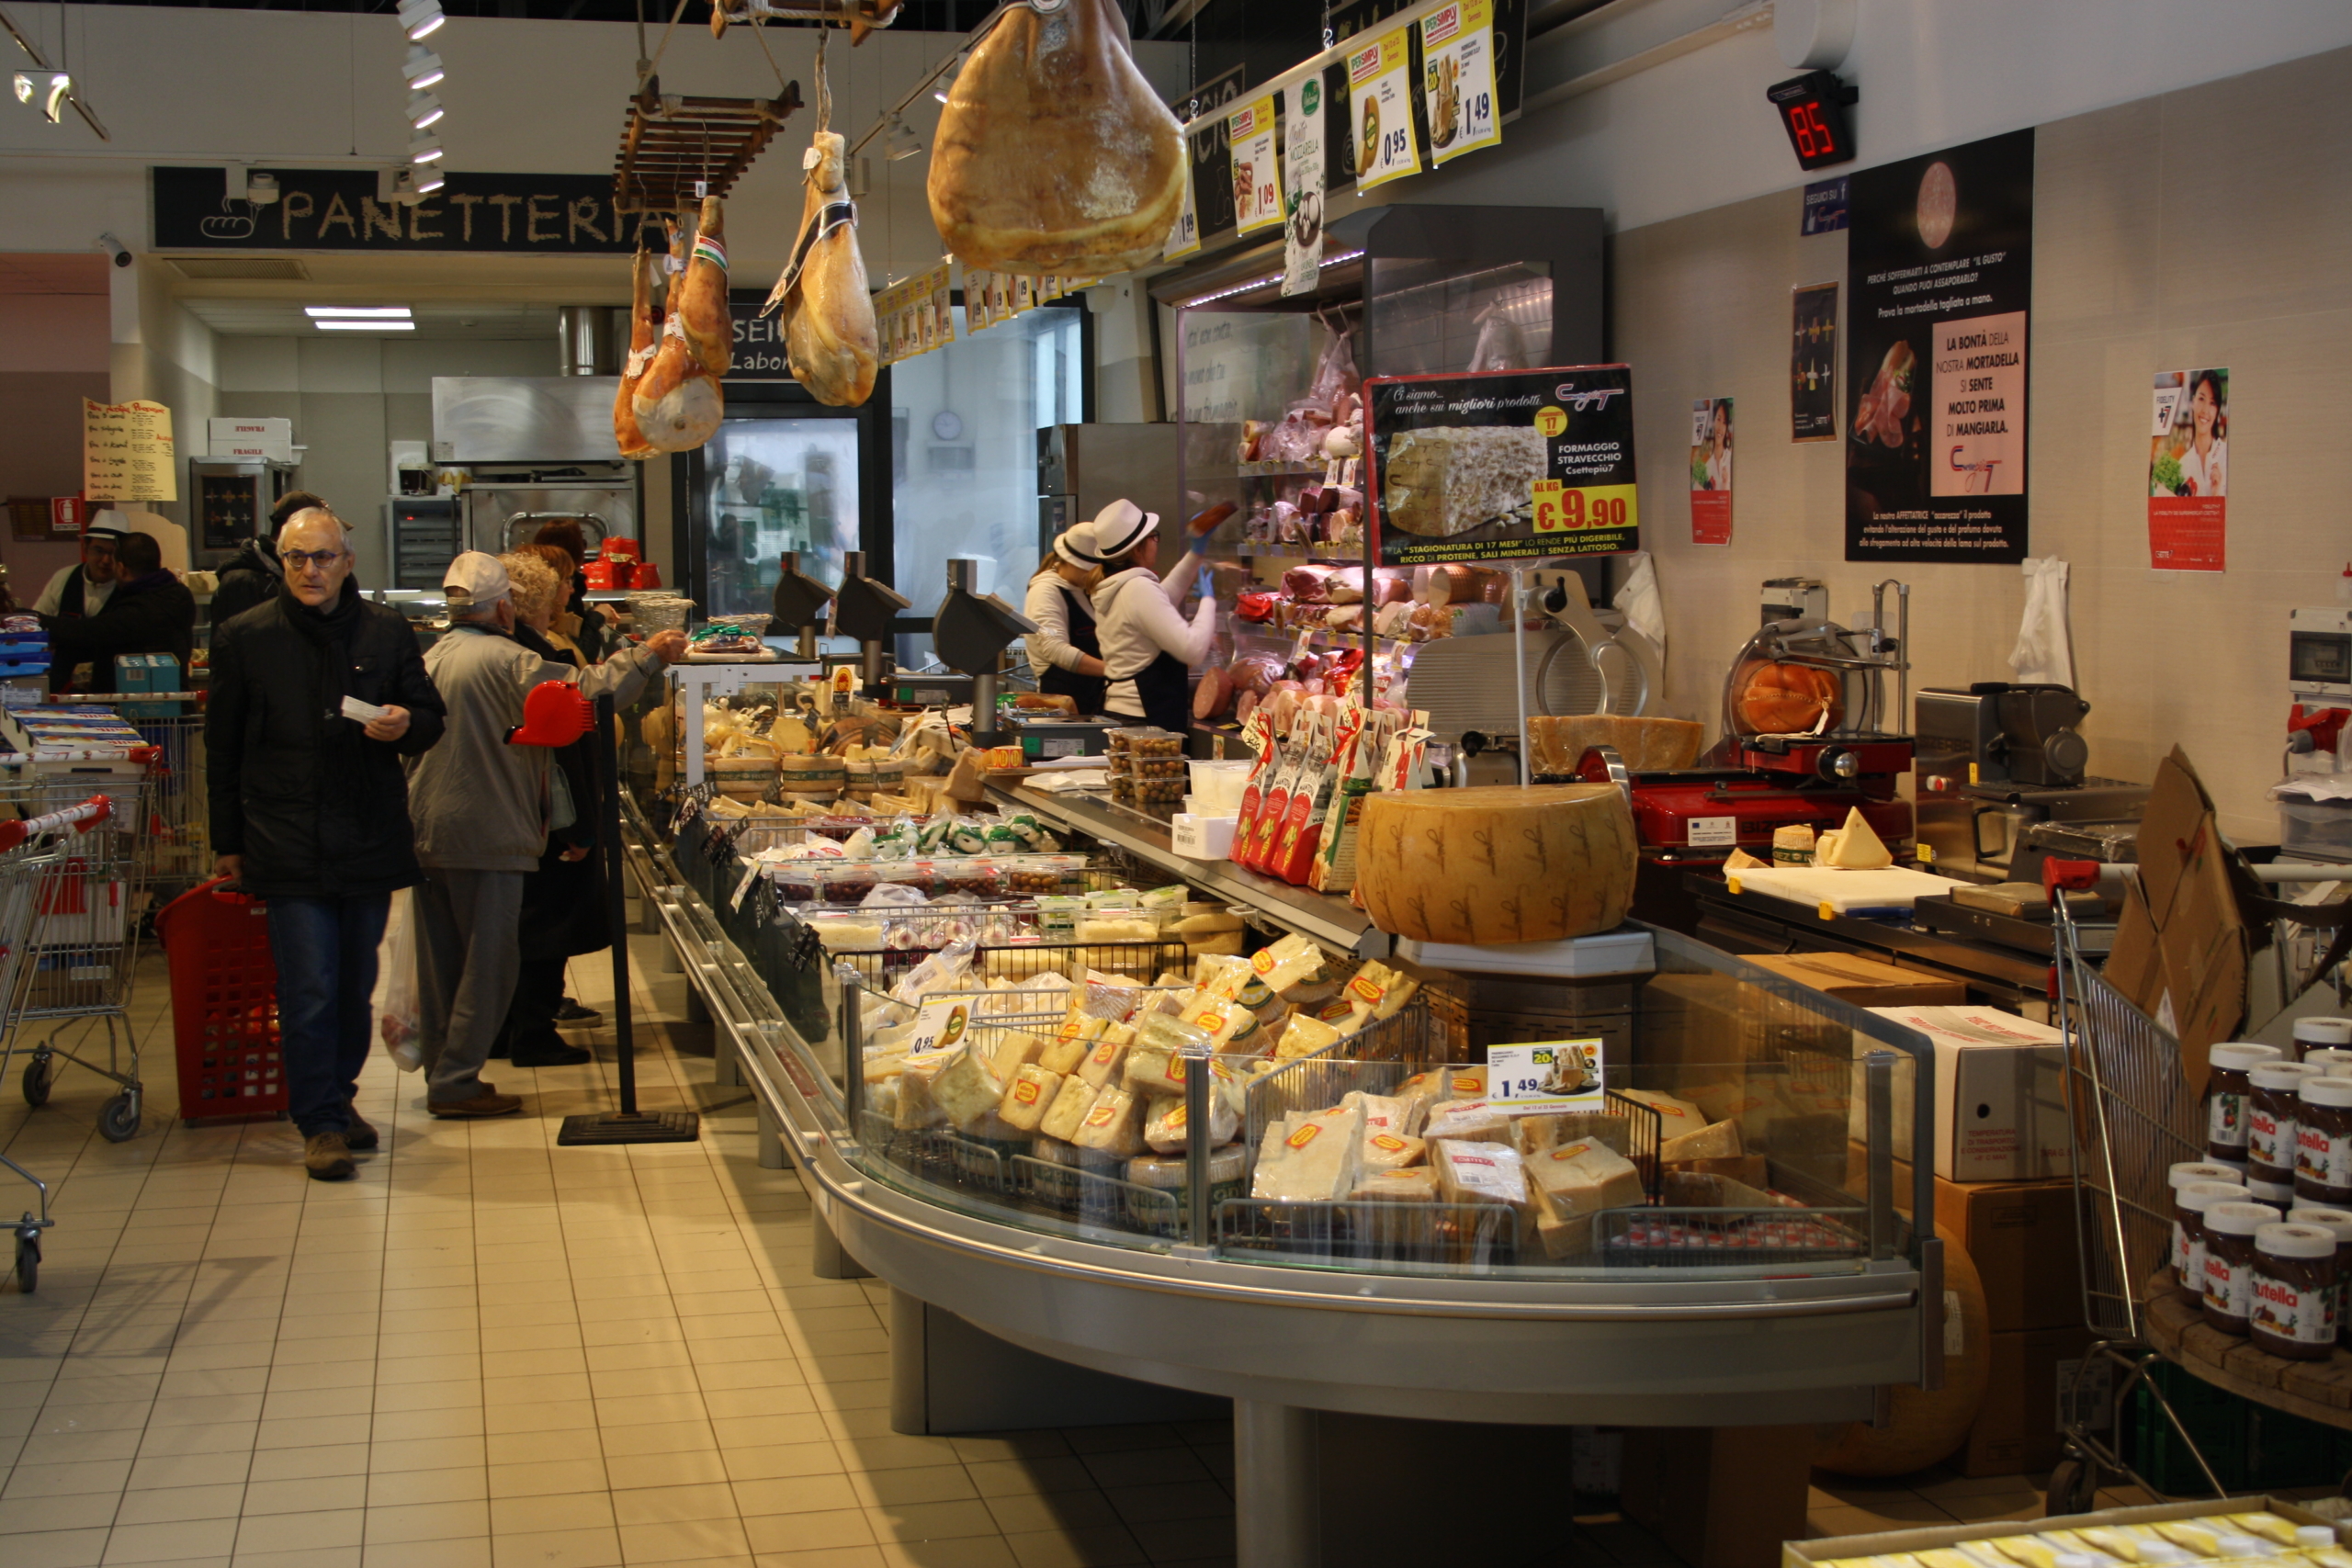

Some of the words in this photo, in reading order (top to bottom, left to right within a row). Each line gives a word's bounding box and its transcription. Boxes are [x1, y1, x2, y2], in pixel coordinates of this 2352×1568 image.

[1790, 102, 1835, 158] 85
[1290, 139, 1319, 161] MOZZARELLA
[1806, 191, 1828, 205] SEGUICI
[1829, 189, 1838, 200] SU
[282, 191, 669, 243] PANETTERIA
[1887, 266, 1923, 281] SOFFERMARTI
[1924, 266, 1929, 275] A
[1929, 258, 1970, 275] CONTEMPLARE
[1893, 282, 1917, 295] QUANDO
[1918, 279, 1933, 290] PUOI
[1933, 272, 1978, 288] ASSAPORARLO?
[1878, 308, 1895, 318] Prova
[1896, 304, 1903, 315] la
[1904, 299, 1938, 313] mortadella
[1939, 296, 1964, 312] tagliata
[1965, 298, 1971, 306] a
[1971, 294, 1993, 305] mano.
[1947, 337, 1956, 351] LA
[1989, 332, 2009, 345] DELLA
[1936, 359, 1963, 374] NOSTRA
[1966, 352, 2019, 370] MORTADELLA
[1961, 379, 1966, 392] SI
[1969, 377, 1993, 392] SENTE
[1394, 389, 1404, 401] Ci
[2156, 395, 2175, 404] FIDELITY
[1395, 404, 1427, 415] anche
[1430, 403, 1445, 412] sui
[1448, 397, 1495, 414] migliori
[1497, 395, 1543, 411] prodotti.
[1948, 400, 1975, 415] MOLTO
[1978, 398, 2005, 412] PRIMA
[1544, 417, 1556, 430] 17
[1947, 423, 1954, 436] DI
[1956, 420, 2008, 436] MANGIARLA.
[1558, 442, 1620, 454] FORMAGGIO
[1557, 453, 1622, 465] STRAVECCHIO
[1534, 482, 1544, 492] AL
[1546, 481, 1559, 491] KG
[1537, 502, 1555, 530] €
[1561, 490, 1626, 530] 9,90
[1895, 511, 1928, 520] AFFETTATRICE
[1963, 510, 1967, 519] il
[1968, 510, 1992, 522] prodotto
[1863, 524, 1883, 534] evitando
[1917, 524, 1927, 534] del
[1927, 525, 1942, 536] gusto
[1948, 524, 1957, 534] del
[1958, 524, 1981, 536] profumo
[1475, 542, 1484, 550] DI
[1486, 541, 1497, 550] 17
[1536, 537, 1561, 546] RENDE
[1579, 534, 1625, 544] DIGERIBILE,
[1870, 537, 1900, 548] sfregamento
[1901, 537, 1908, 547] ad
[1910, 537, 1921, 547] alta
[1973, 537, 1982, 547] sul
[1400, 556, 1425, 564] RICCO
[1437, 552, 1479, 561] PROTEINE,
[1480, 550, 1498, 558] SALI
[1500, 548, 1539, 557] MINERALI
[1547, 546, 1576, 554] SENZA
[1577, 543, 1619, 552] LATTOSIO.
[1502, 1078, 1538, 1099] 1,49
[1968, 1129, 2016, 1137] TEMPERATURA
[1976, 1137, 2016, 1145] TRASPORTO
[1967, 1145, 2020, 1155] CONSERVAZIONE
[2252, 1280, 2299, 1308] nutella
